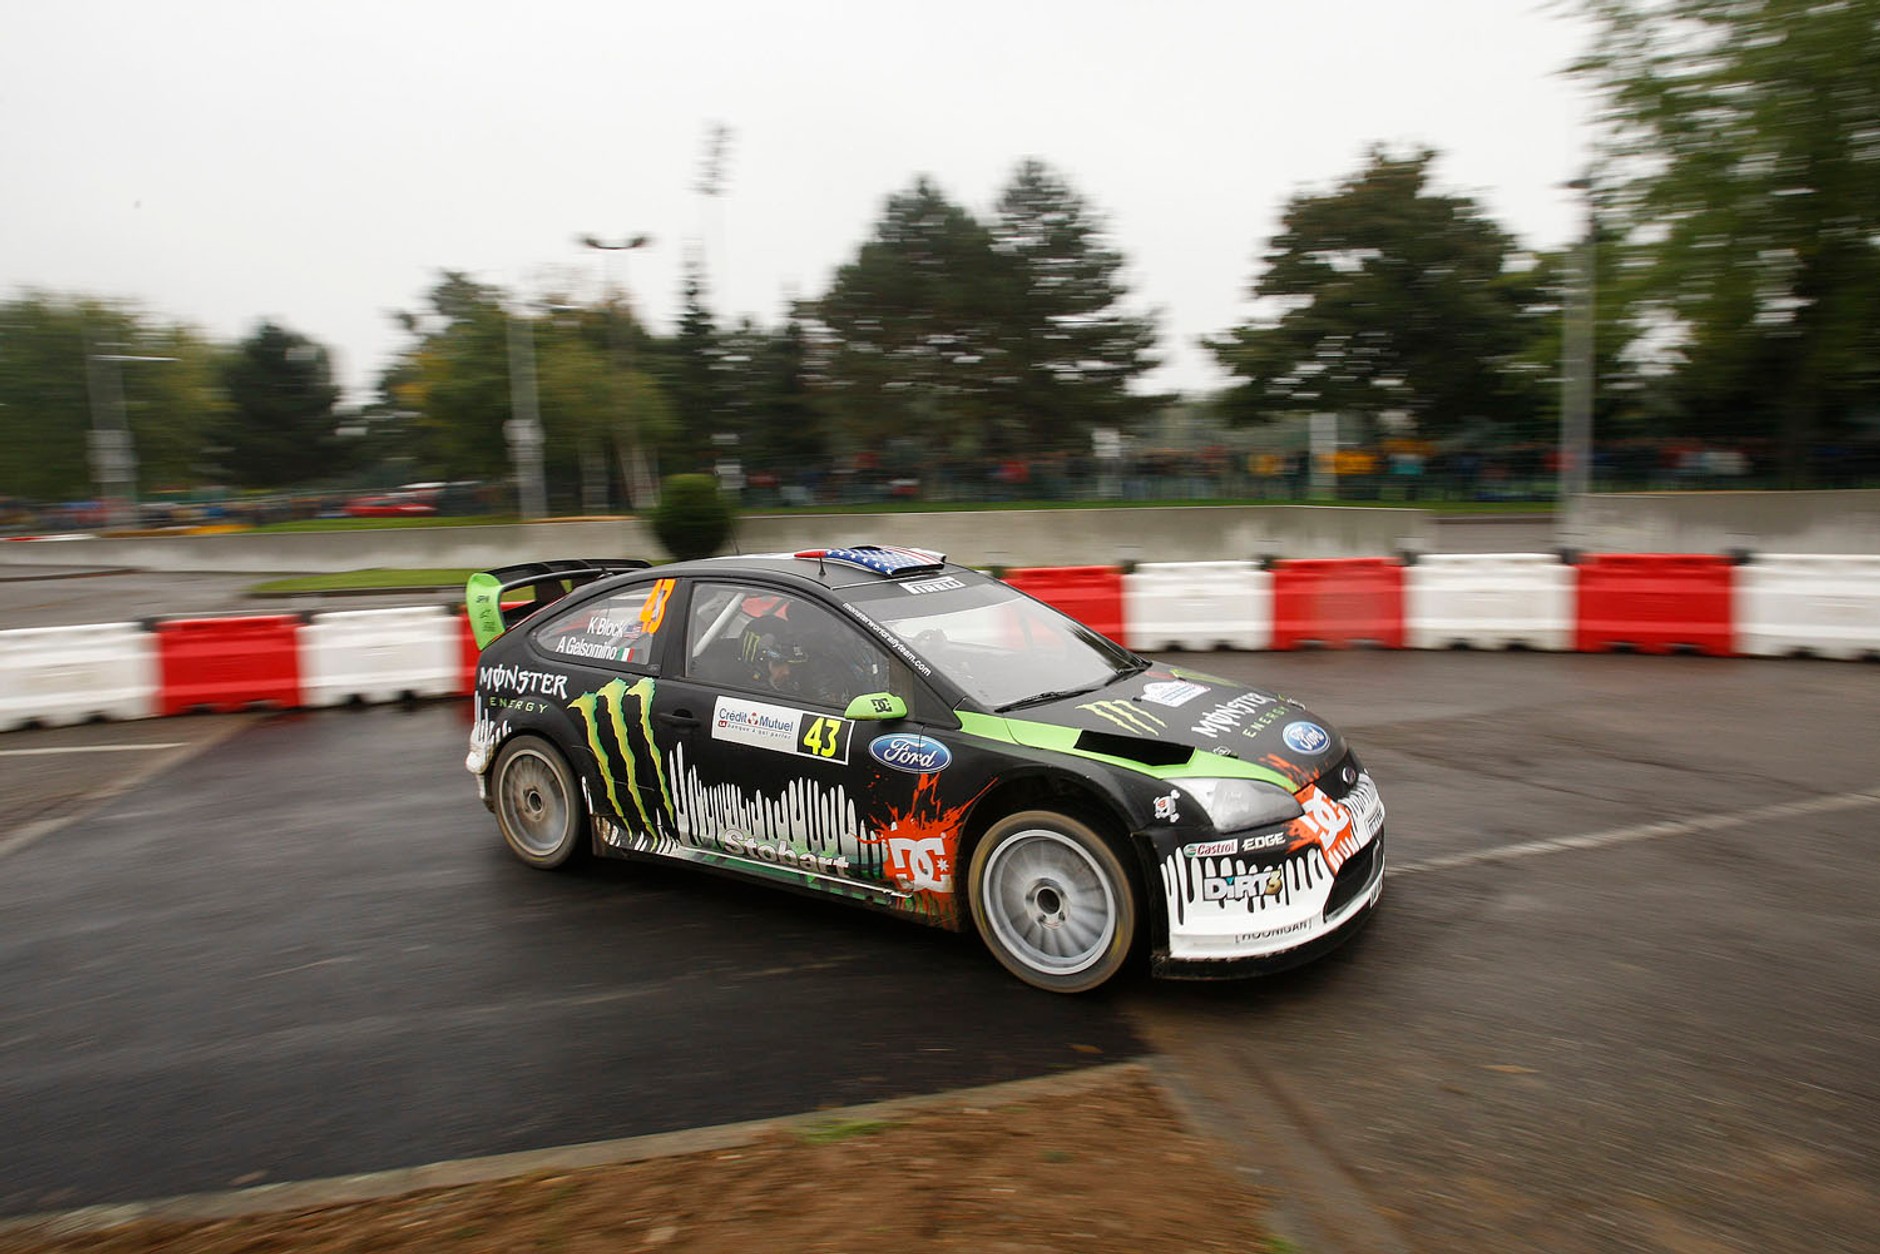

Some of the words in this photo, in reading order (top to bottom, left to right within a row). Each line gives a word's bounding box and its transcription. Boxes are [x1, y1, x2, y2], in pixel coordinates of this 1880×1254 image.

[898, 576, 966, 594] PIRELLI
[586, 617, 598, 634] K
[596, 618, 627, 638] Block
[555, 636, 566, 653] A
[566, 637, 618, 660] Gelsomino
[490, 697, 548, 714] ENERGY
[871, 698, 892, 713] DC
[719, 707, 748, 723] Crédit
[759, 715, 794, 732] Mutuel
[1242, 706, 1290, 738] ENERGY
[803, 717, 842, 758] 43
[1290, 726, 1326, 750] Ford
[883, 738, 935, 768] Ford
[724, 829, 850, 877] Stobart
[1197, 842, 1236, 855] Castrol
[1242, 832, 1286, 851] EDGE
[888, 837, 954, 893] DC
